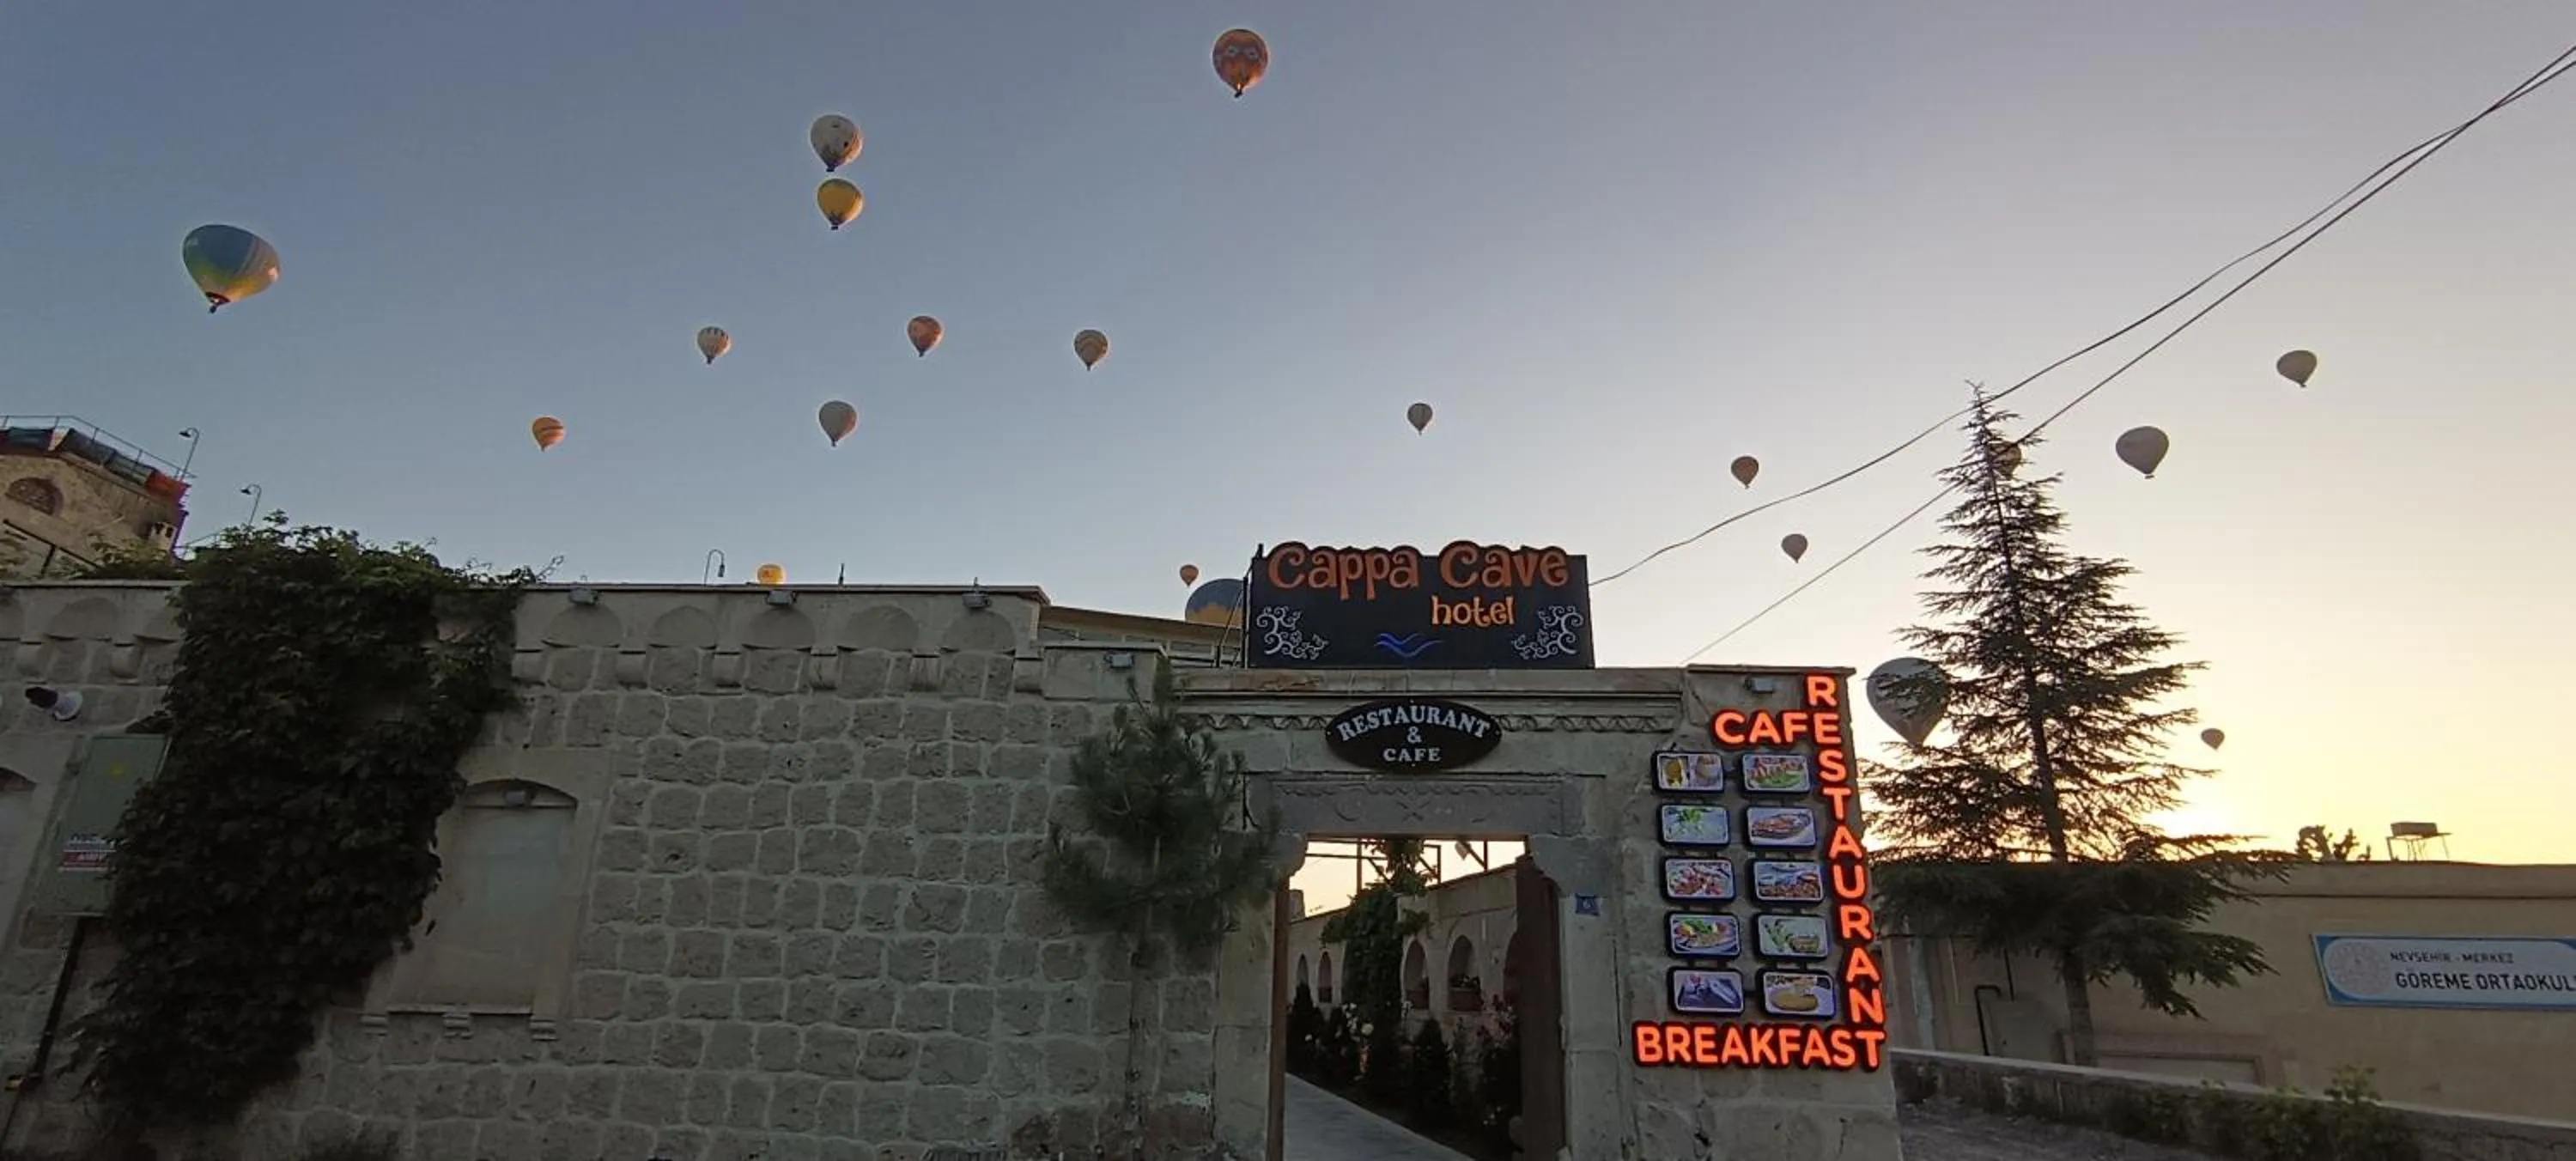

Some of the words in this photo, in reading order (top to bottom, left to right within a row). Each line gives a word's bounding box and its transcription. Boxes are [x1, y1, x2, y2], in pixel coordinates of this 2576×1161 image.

[1267, 542, 1420, 600] Cappa
[1439, 542, 1571, 589] Cave
[1431, 594, 1516, 628] hotel
[1336, 706, 1492, 742] RESTAURANT
[1406, 726, 1423, 745] &
[1714, 711, 1843, 745] CAFE
[1382, 748, 1442, 763] CAFE
[1807, 675, 1886, 1067] RESTAURANT
[2462, 952, 2514, 963] MERKEZ
[2475, 973, 2576, 992] ORTAOKUL
[1636, 1025, 1886, 1067] BREAKFAST
